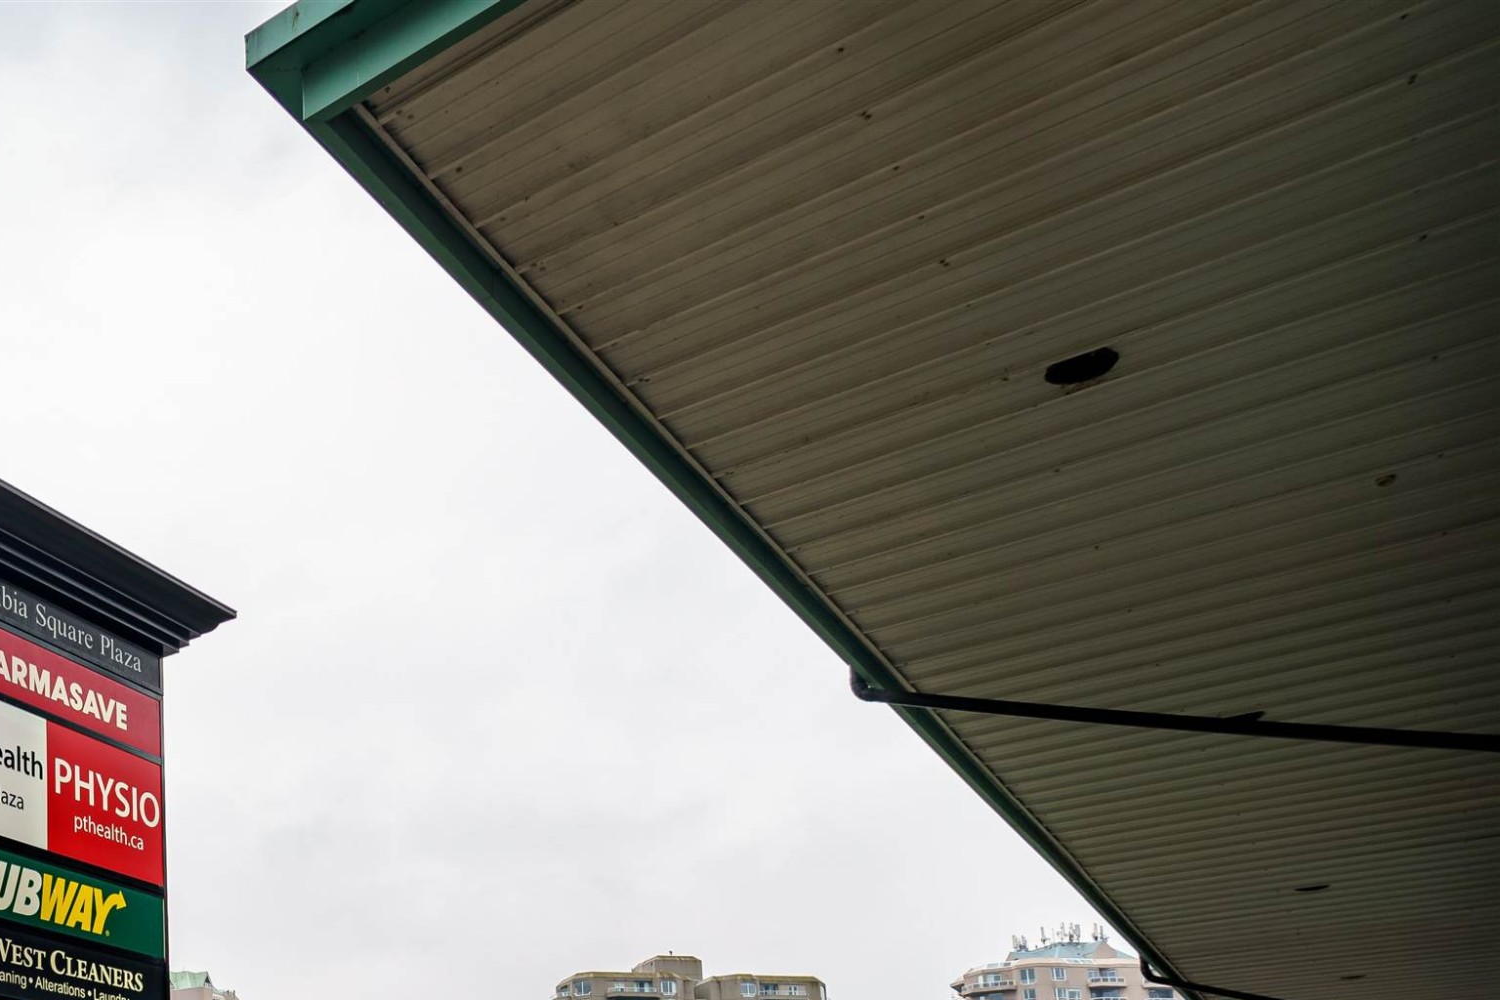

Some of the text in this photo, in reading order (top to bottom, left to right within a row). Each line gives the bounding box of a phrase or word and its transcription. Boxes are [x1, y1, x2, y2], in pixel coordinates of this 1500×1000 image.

[35, 603, 94, 650] Square
[100, 633, 142, 673] Plaza
[54, 757, 160, 828] PHYSIO
[74, 815, 144, 851] pthealth.ca
[34, 976, 86, 999] Alterations
[50, 950, 144, 992] CLEANERS
